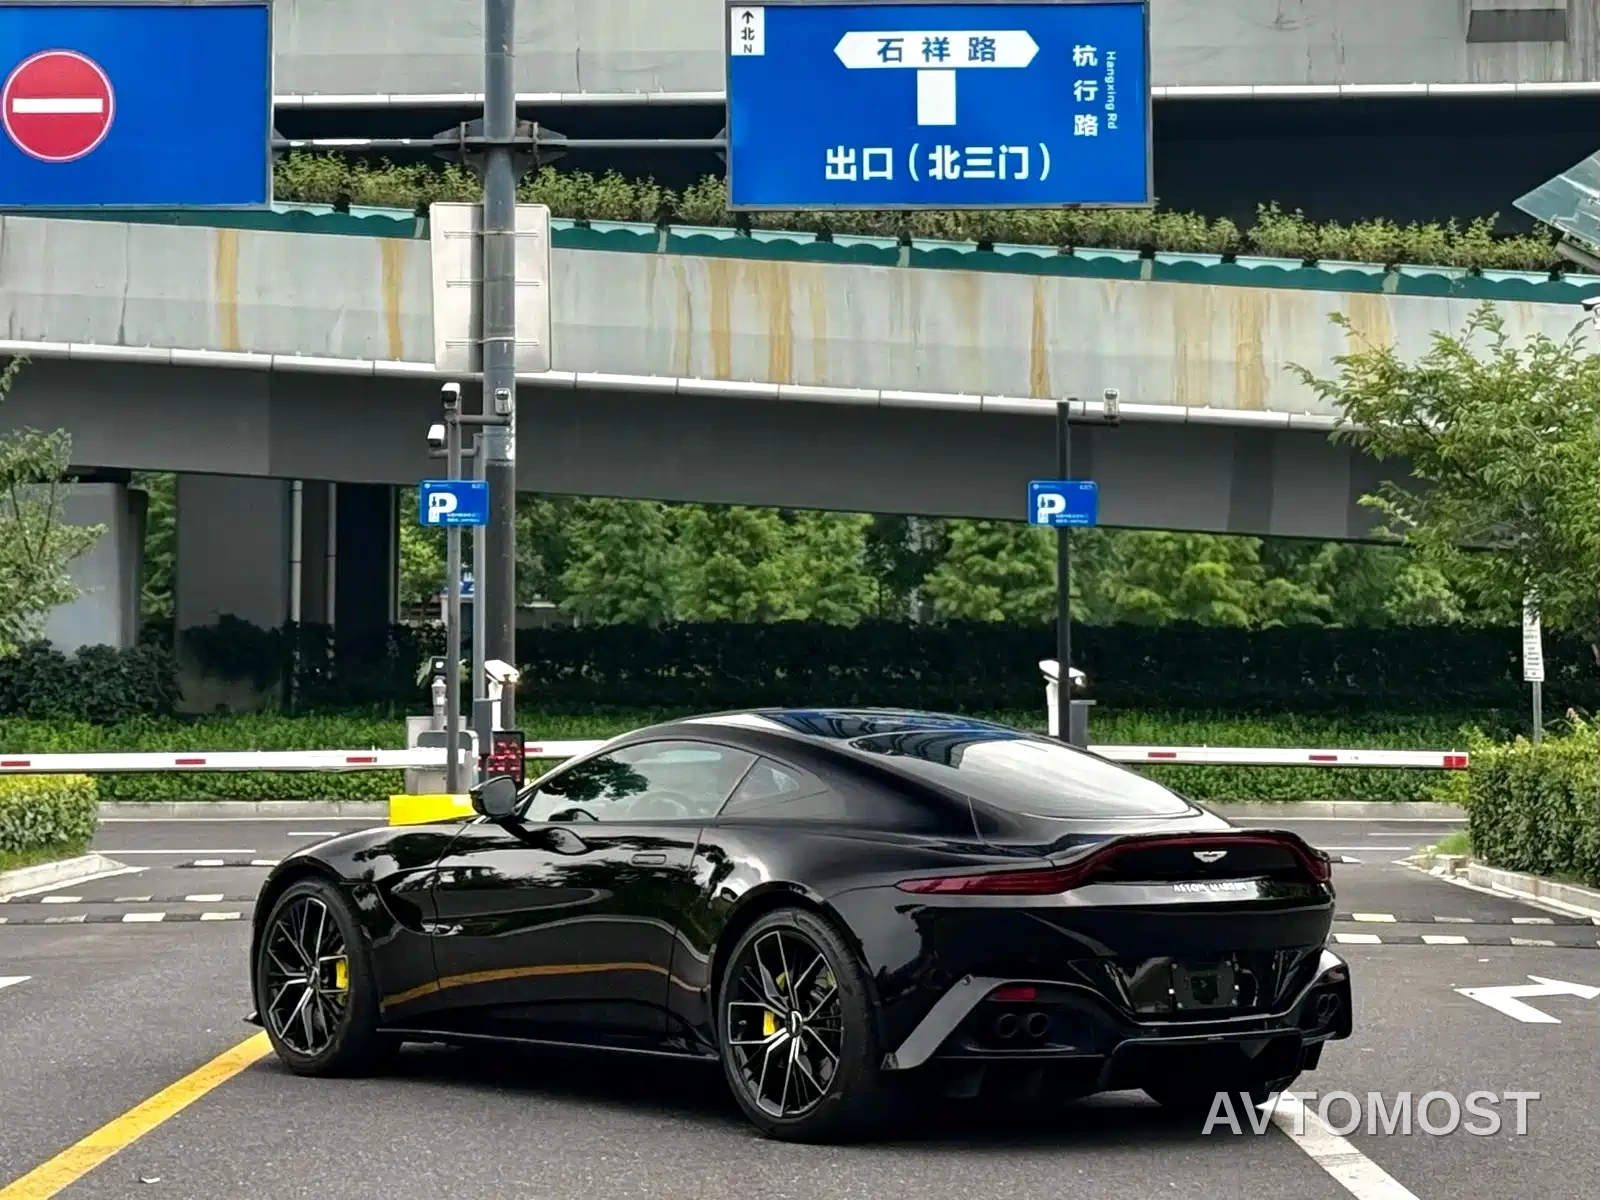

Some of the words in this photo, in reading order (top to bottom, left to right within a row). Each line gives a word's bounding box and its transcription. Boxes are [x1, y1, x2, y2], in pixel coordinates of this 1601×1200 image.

[741, 27, 755, 41] 北
[744, 44, 752, 53] N
[877, 36, 996, 63] 石祥路
[1072, 45, 1099, 137] 杭行路
[1104, 51, 1117, 110] Hangxing
[1107, 113, 1118, 129] Rd
